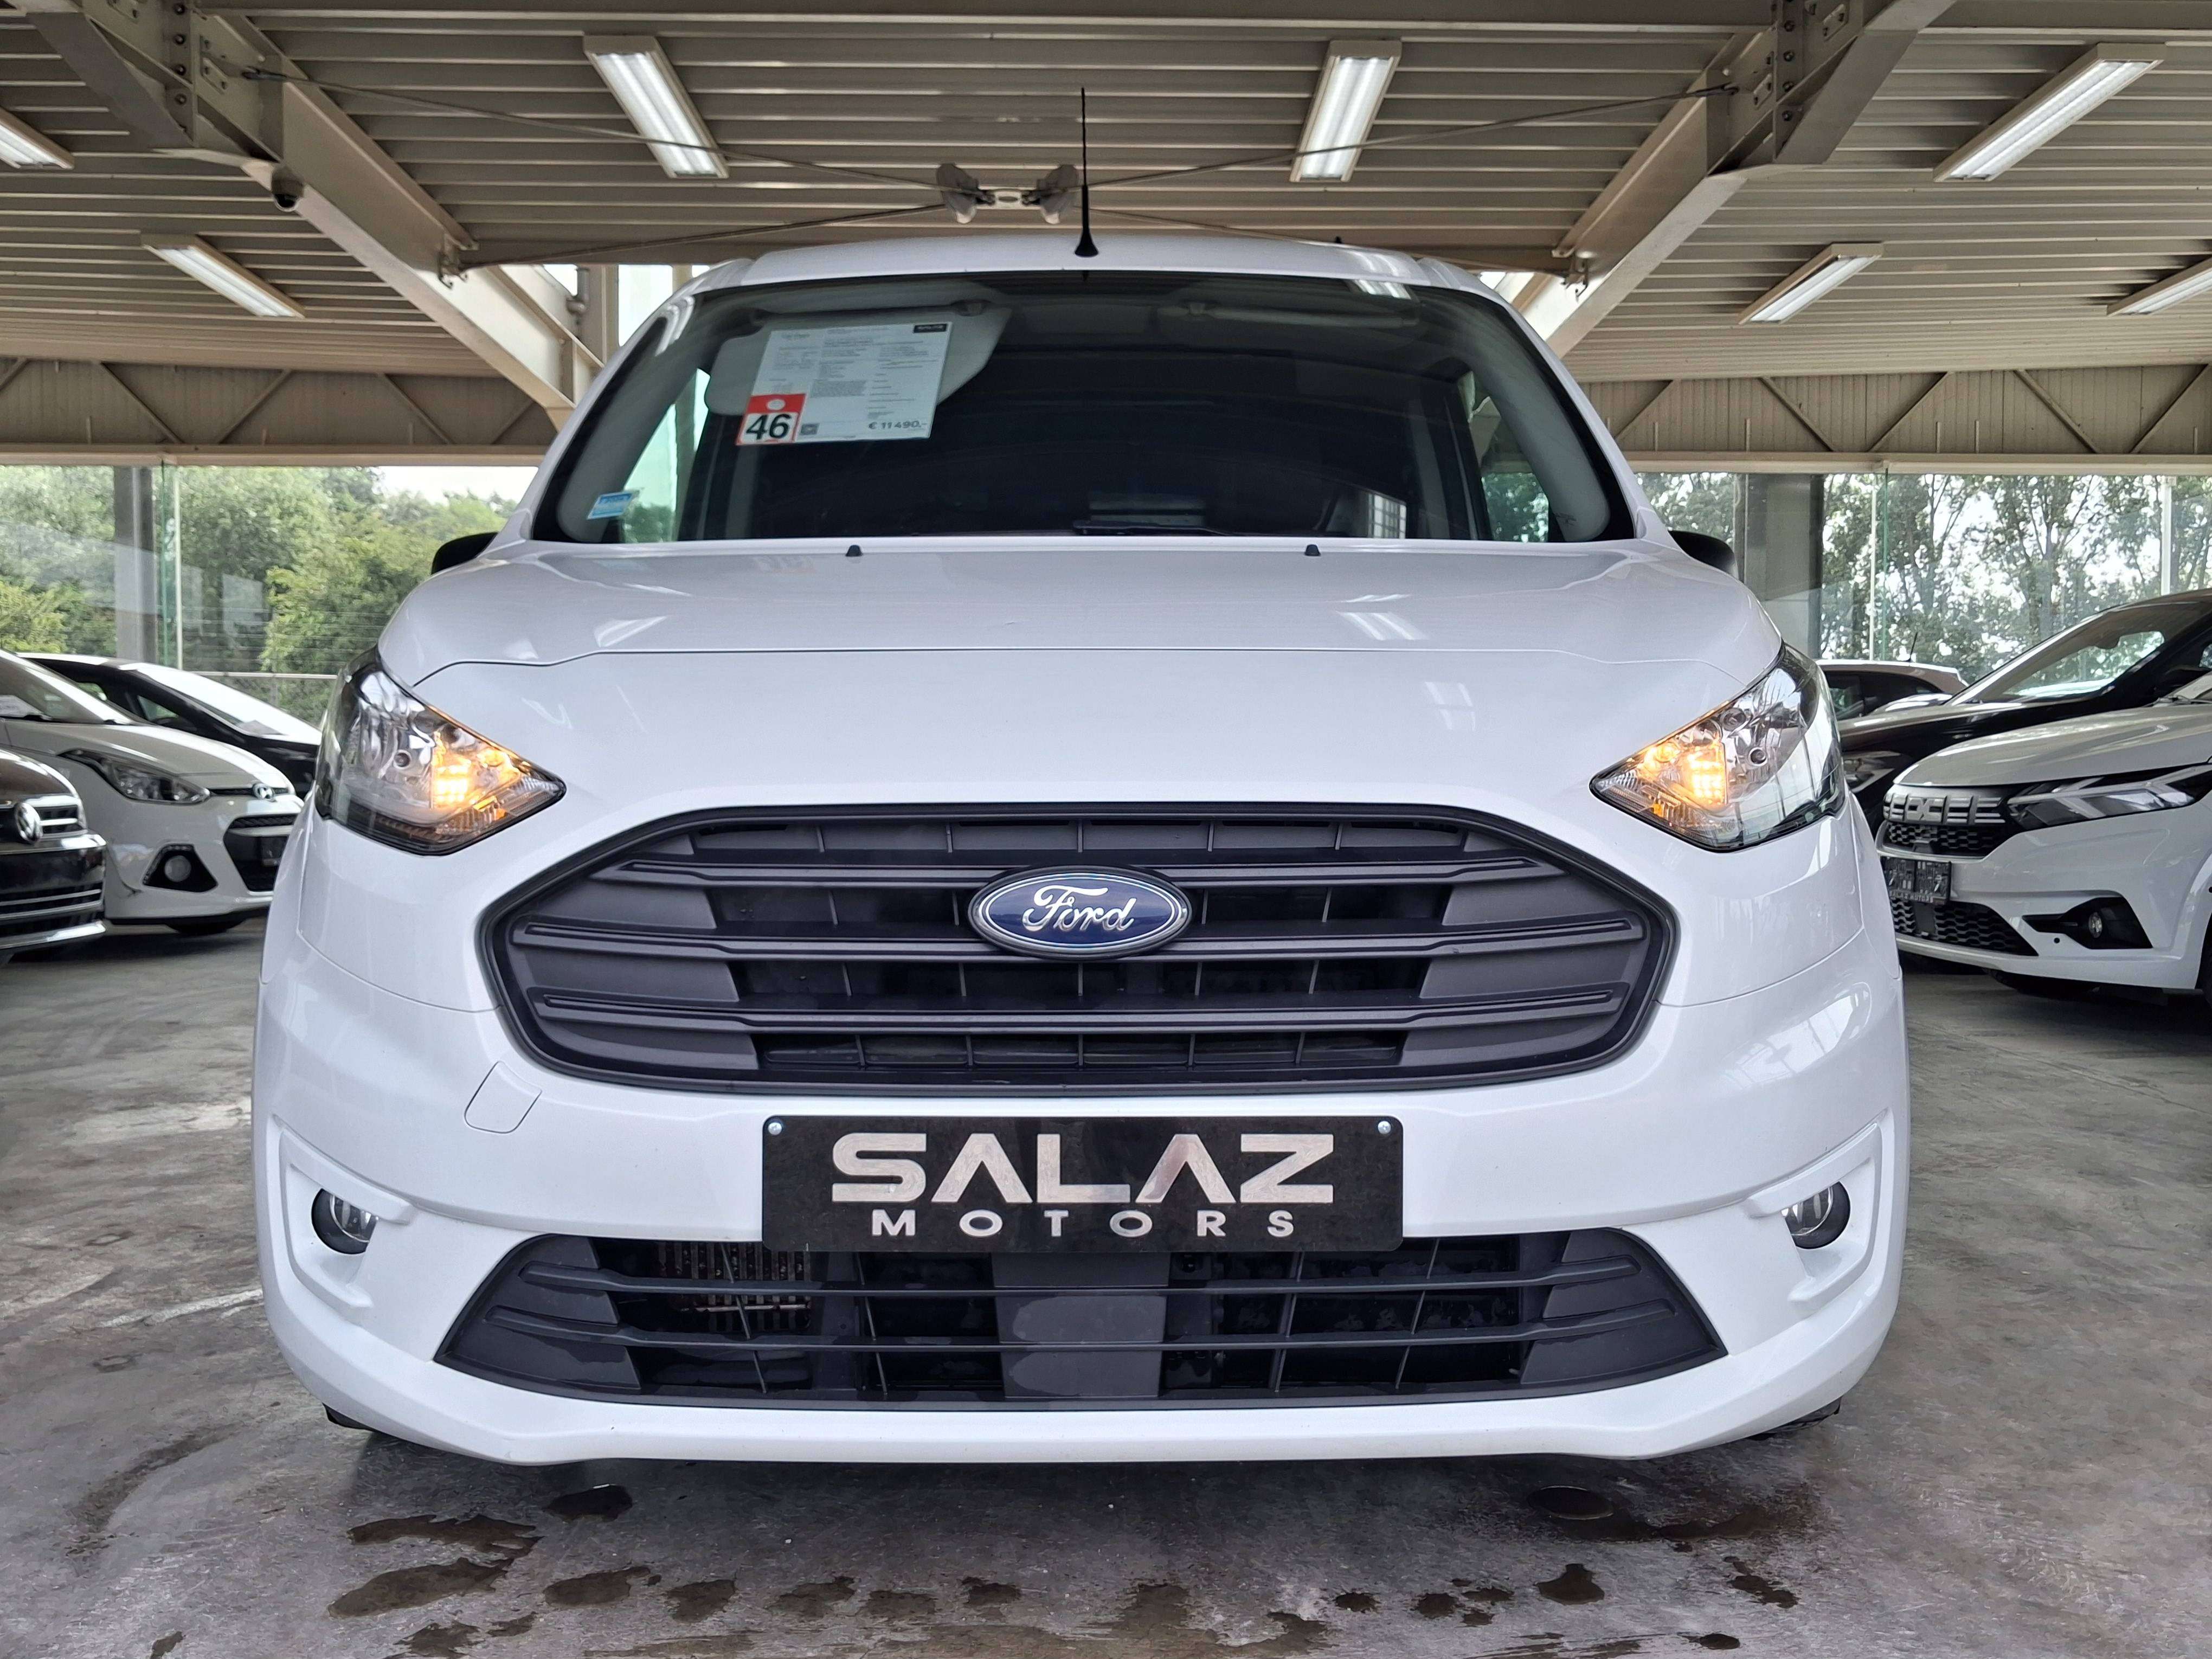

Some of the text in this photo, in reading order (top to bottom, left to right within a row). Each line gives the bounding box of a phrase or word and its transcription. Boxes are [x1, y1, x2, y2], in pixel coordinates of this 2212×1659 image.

[746, 414, 792, 440] 46
[1022, 884, 1137, 931] Ford
[832, 1133, 1334, 1203] SALAZ
[871, 1210, 1294, 1237] MOTORS
